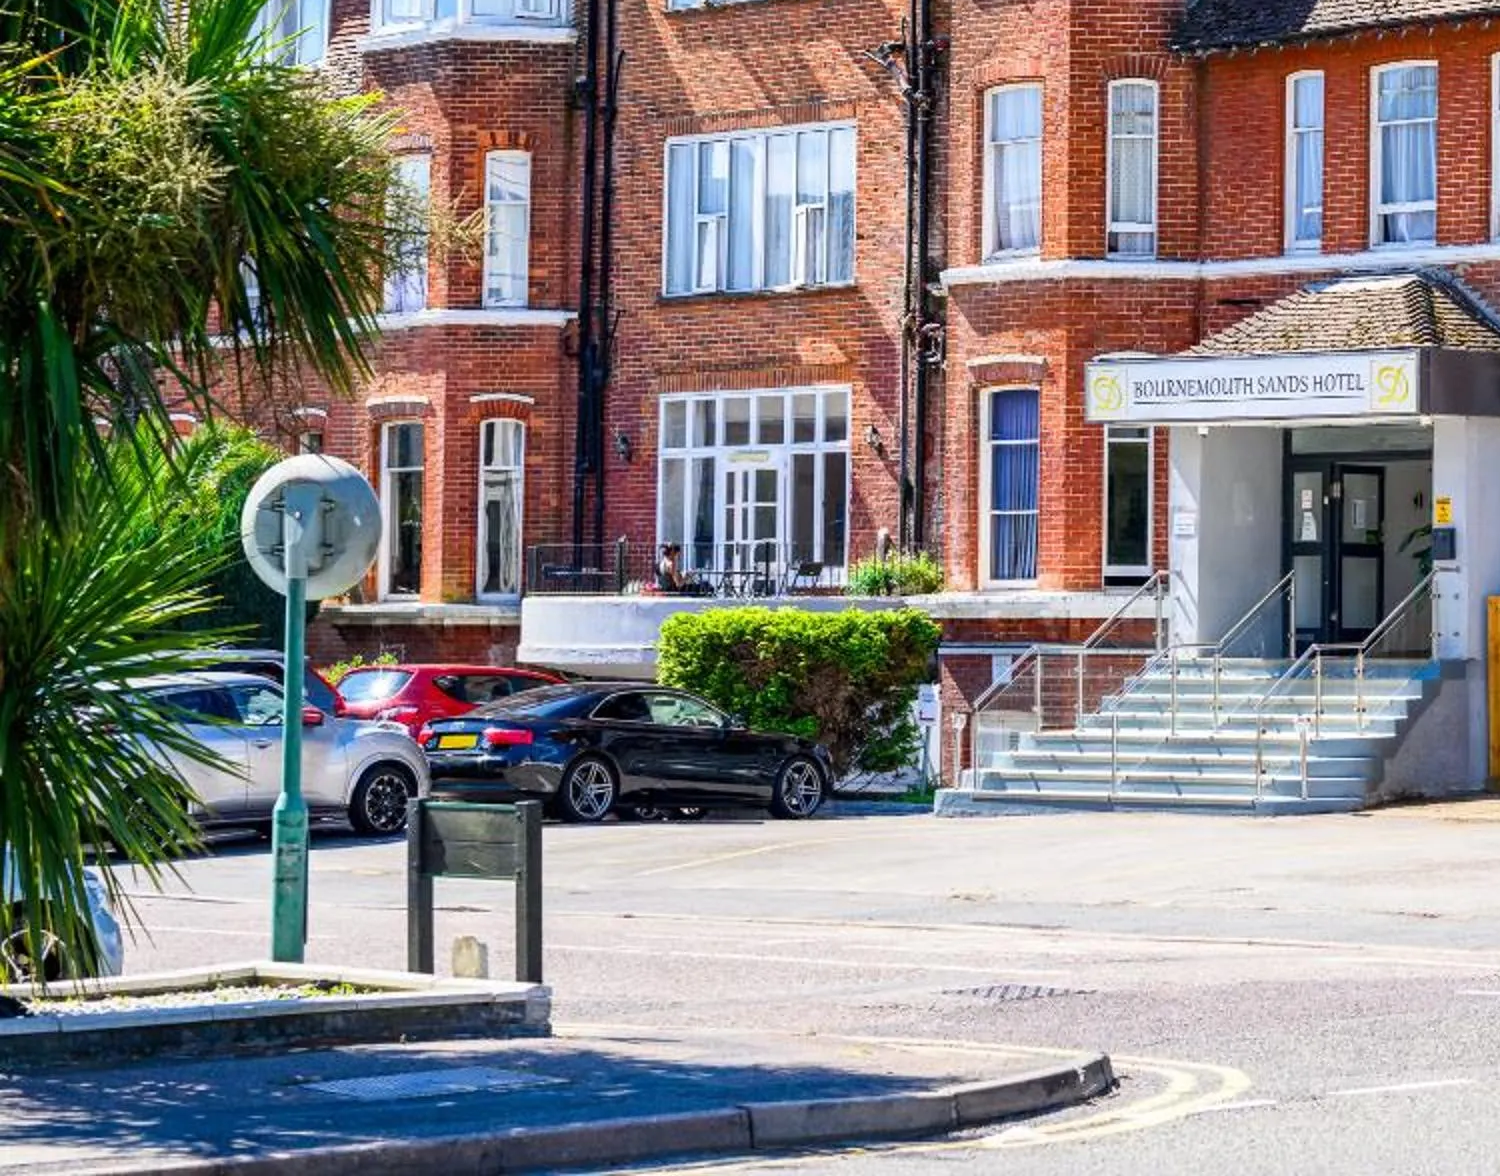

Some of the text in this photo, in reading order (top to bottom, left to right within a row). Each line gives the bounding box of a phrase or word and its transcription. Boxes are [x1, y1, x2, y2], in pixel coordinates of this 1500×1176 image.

[1133, 373, 1365, 399] BOURNEMOUTH SANDS HOTEL
